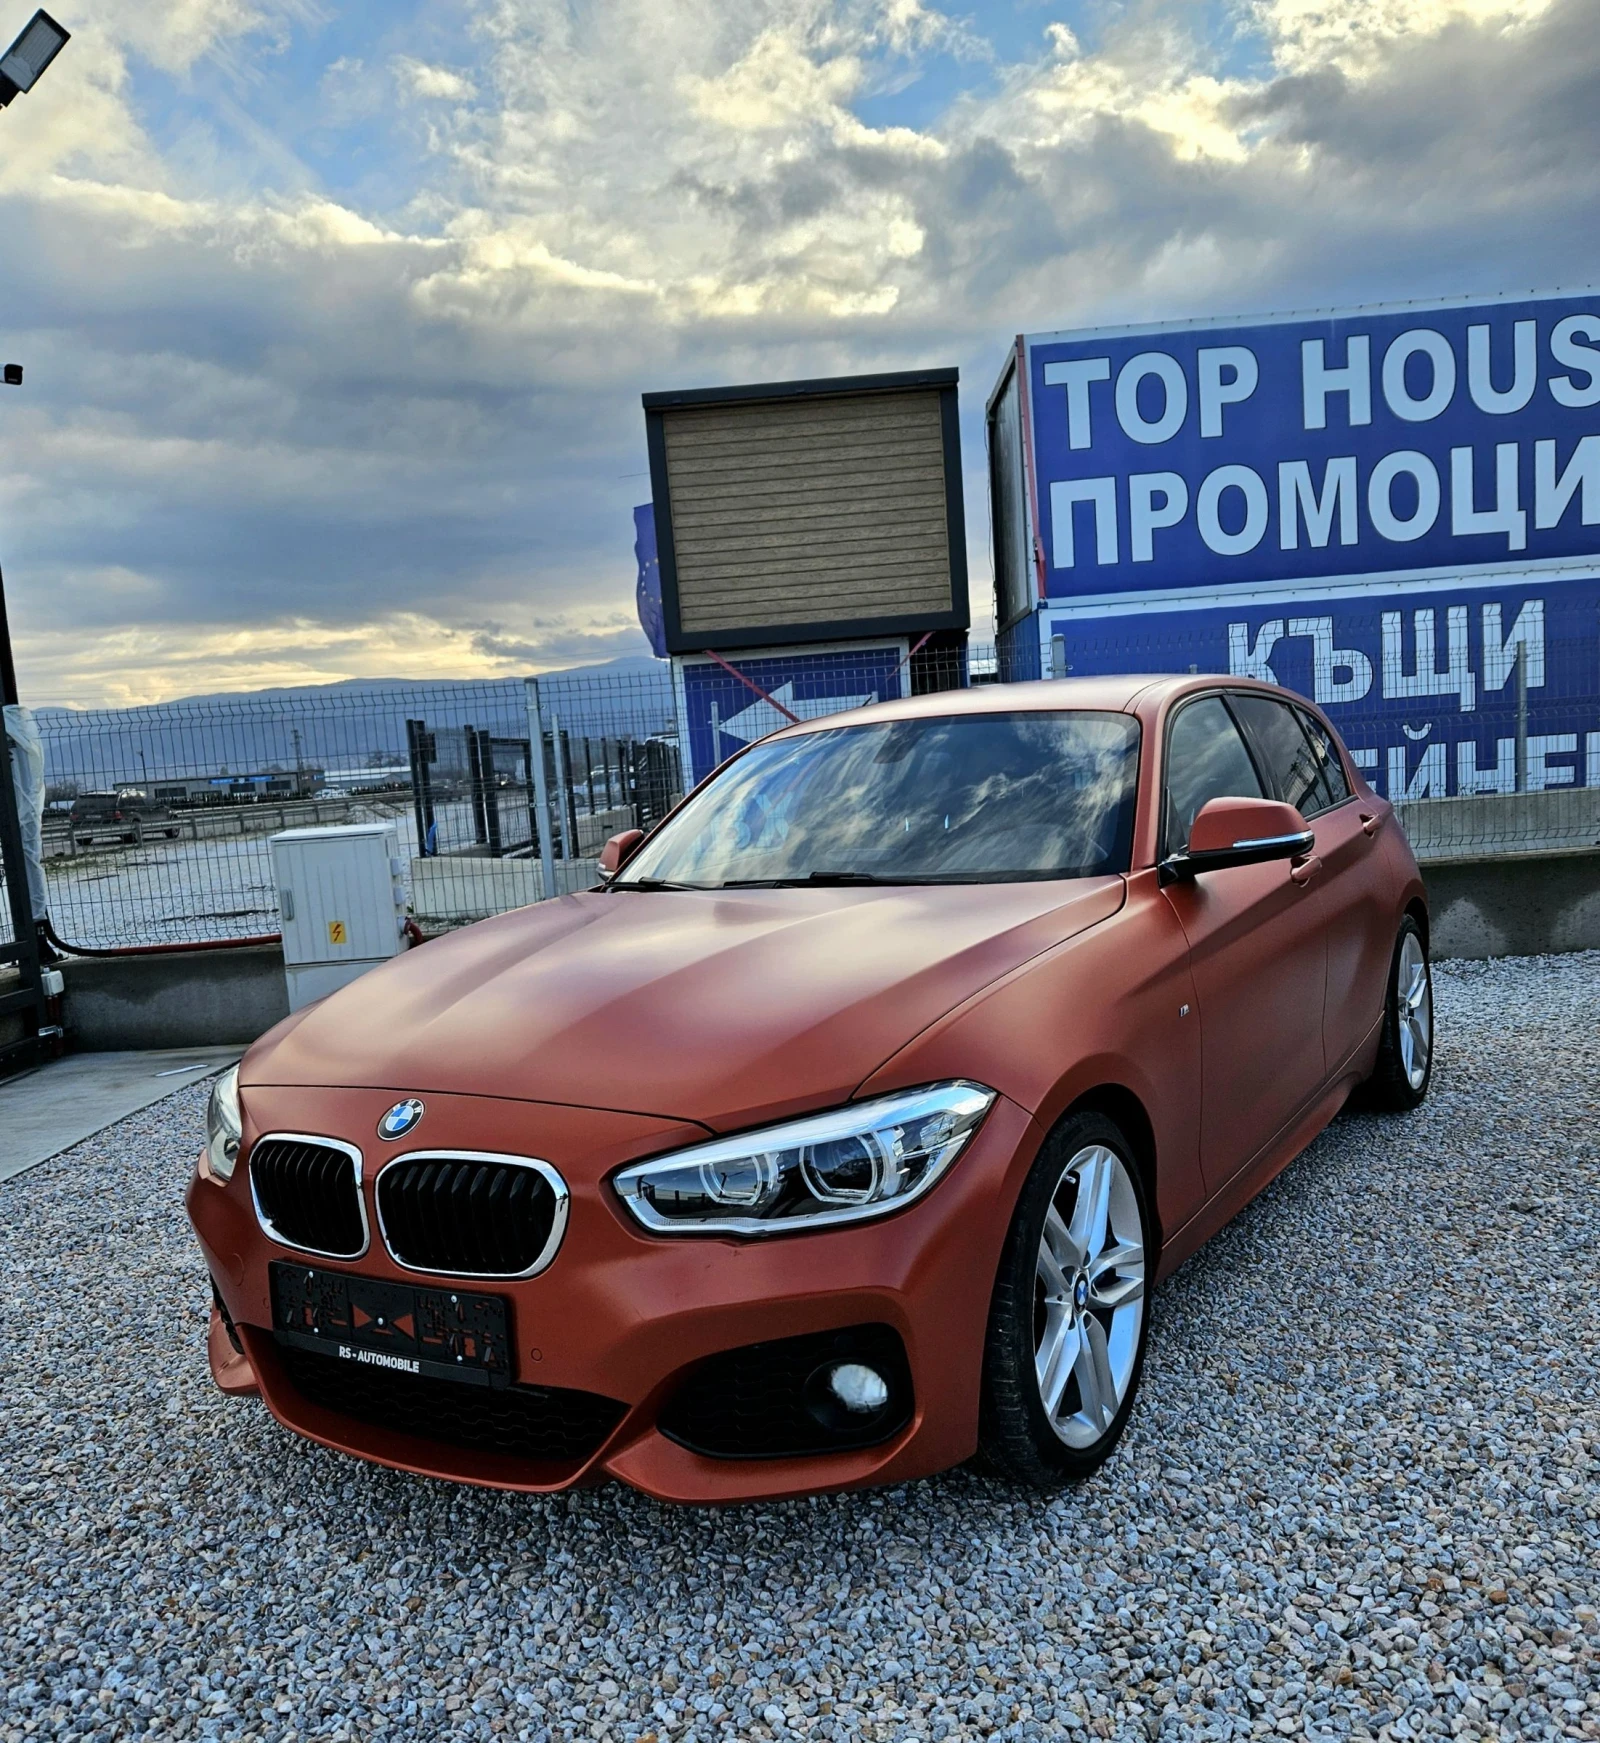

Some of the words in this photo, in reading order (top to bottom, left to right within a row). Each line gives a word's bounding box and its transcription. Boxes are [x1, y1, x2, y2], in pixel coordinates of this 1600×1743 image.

[1044, 345, 1259, 451] TOP
[1301, 313, 1600, 430] HOUS
[1049, 434, 1600, 569] ПРОМОЦИ
[1228, 599, 1546, 712] КЪЩИ
